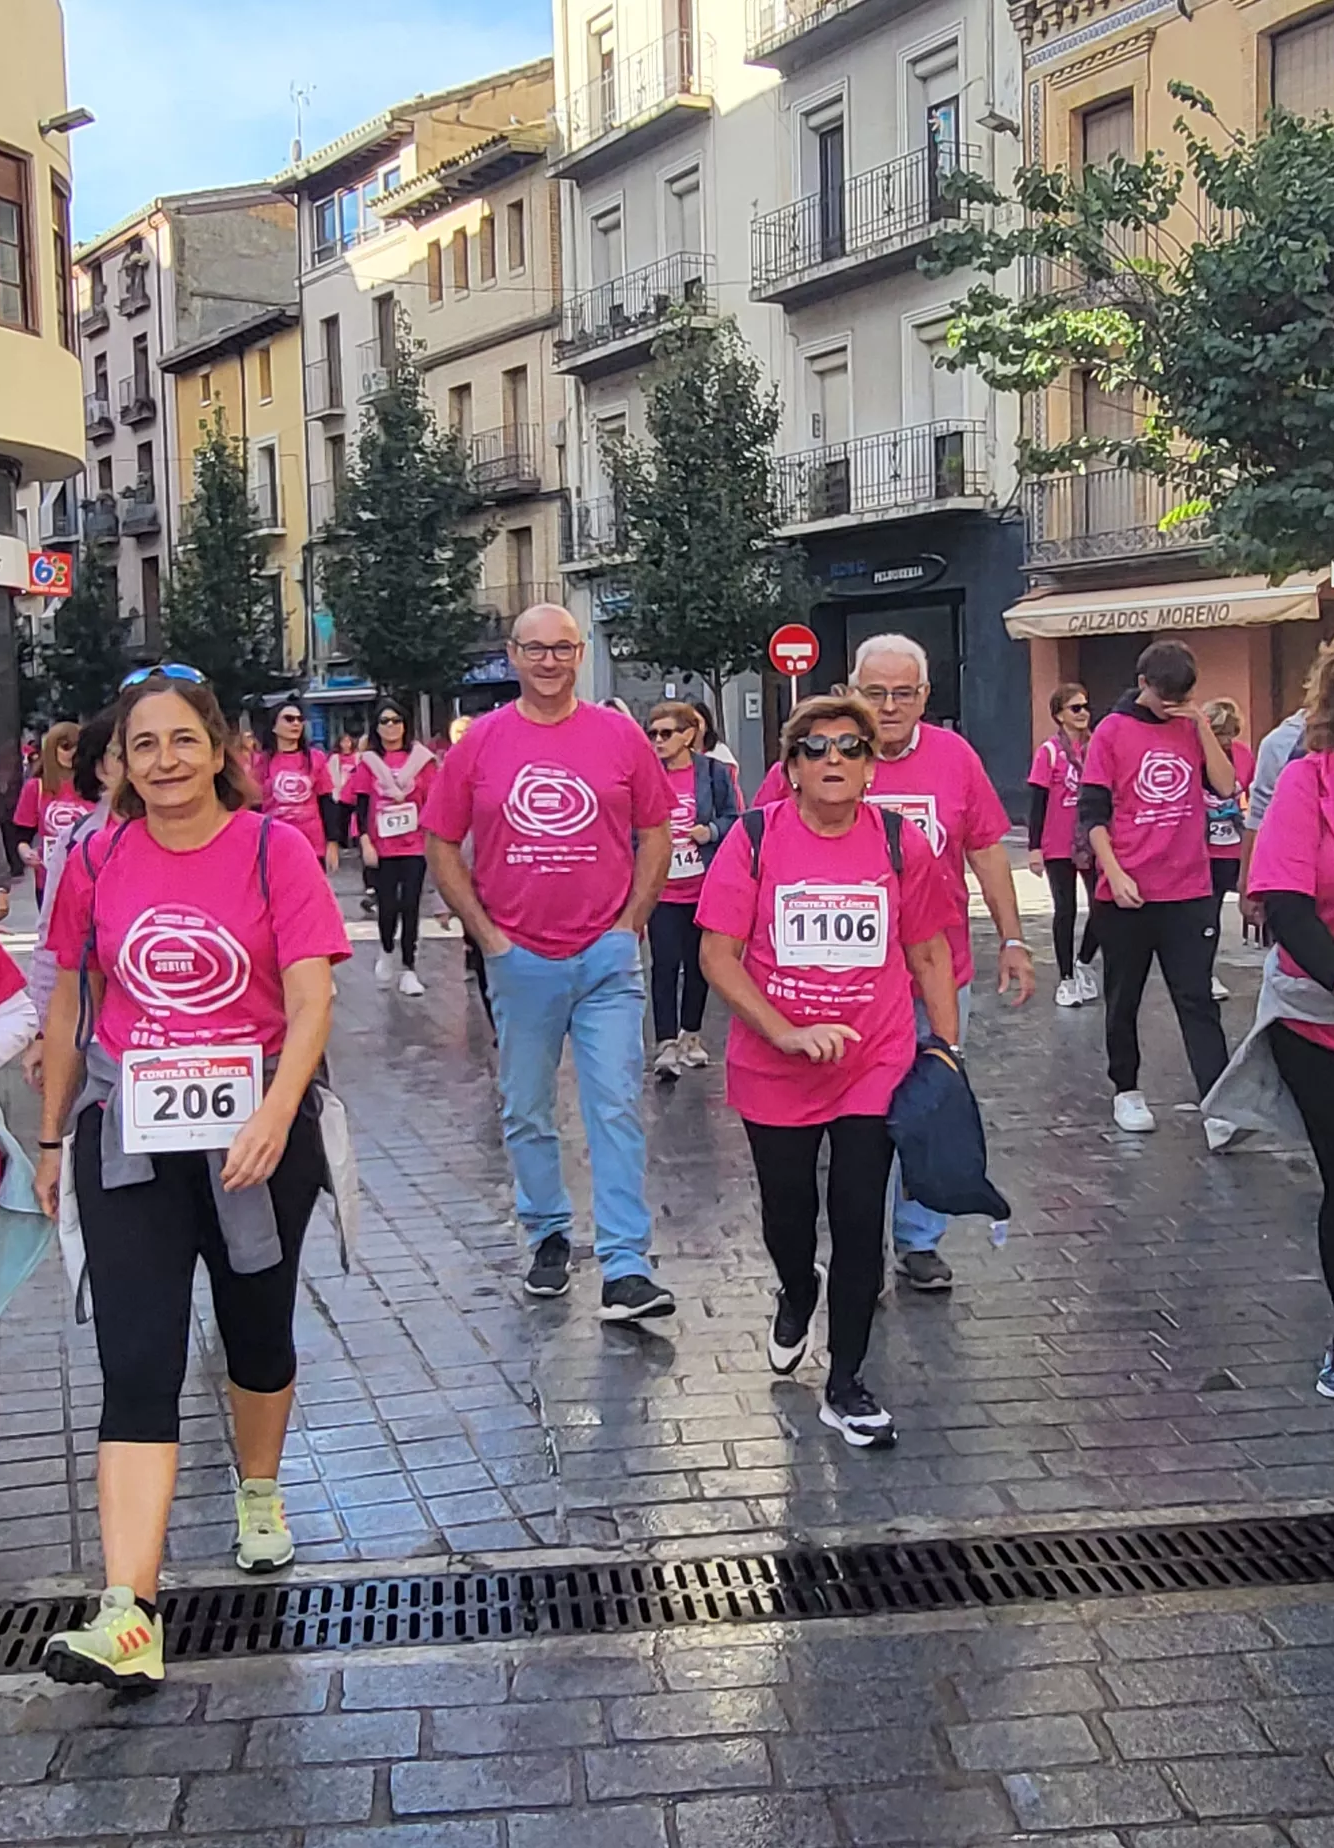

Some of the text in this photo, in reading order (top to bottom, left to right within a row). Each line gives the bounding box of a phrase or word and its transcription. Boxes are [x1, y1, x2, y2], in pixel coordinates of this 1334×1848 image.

[1068, 603, 1230, 633] CALZADOS MORENO
[386, 814, 410, 828] 673
[789, 913, 877, 942] 1106
[139, 1065, 248, 1080] CONTRA EL CÁNCER
[152, 1082, 236, 1122] 206
